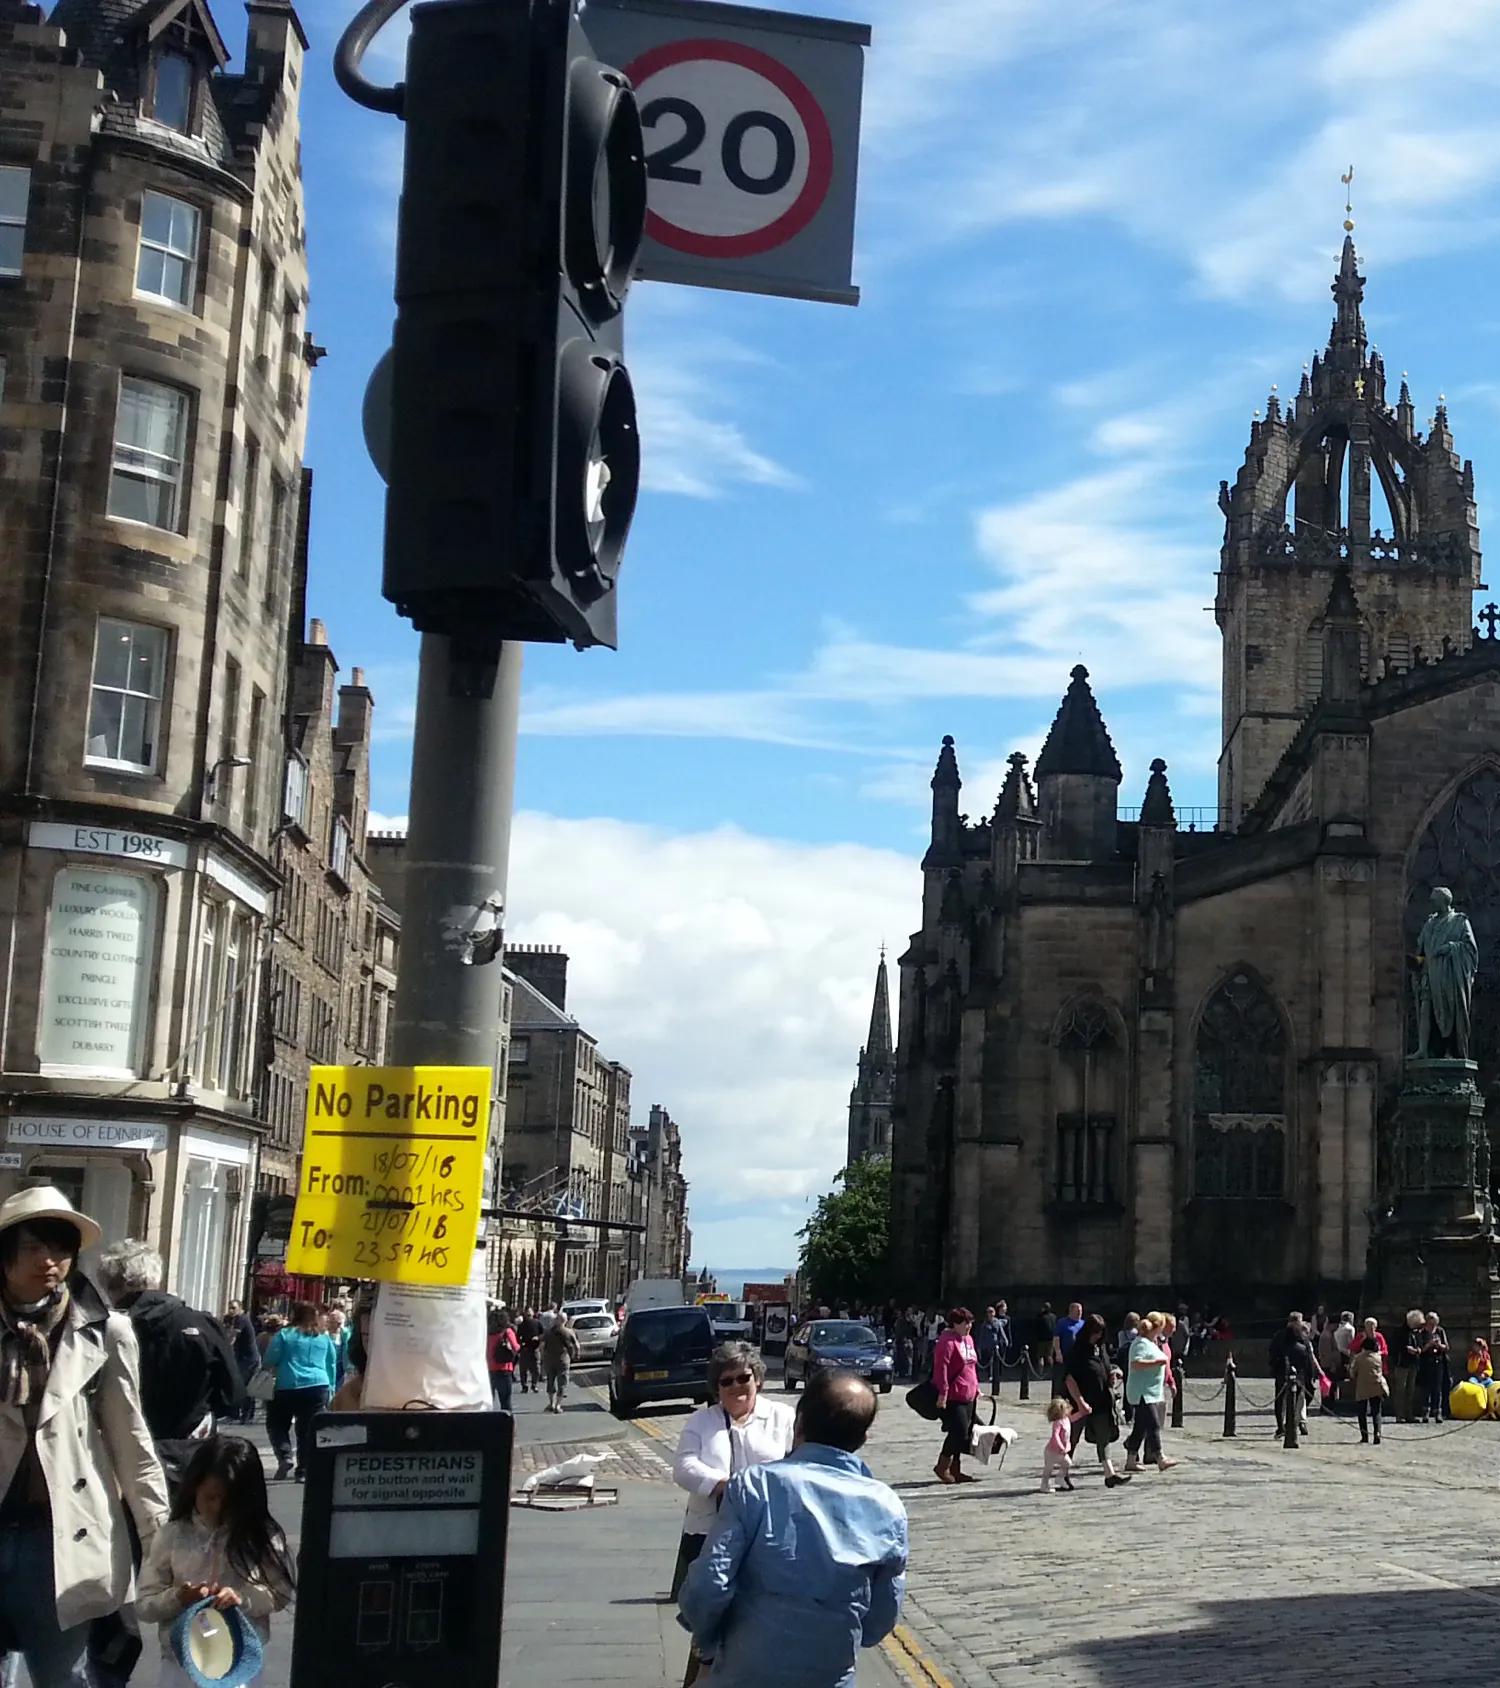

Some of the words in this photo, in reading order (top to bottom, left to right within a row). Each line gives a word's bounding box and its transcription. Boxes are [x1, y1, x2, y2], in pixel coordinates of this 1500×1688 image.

[641, 96, 796, 195] 20
[74, 828, 117, 851] EST
[121, 834, 164, 857] 1985
[59, 904, 97, 916] LUXURY
[69, 927, 103, 938] HARRIS
[106, 930, 134, 942] TWEED
[51, 947, 99, 960] COUNTRY
[101, 952, 144, 966] CLOTHING
[81, 972, 118, 984] PRINGLE
[58, 995, 109, 1007] EXCLUSIVE
[54, 1018, 102, 1029] SCOTTISH
[72, 1040, 115, 1054] DUBARRY
[314, 1082, 353, 1118] No
[365, 1083, 479, 1128] Parking
[9, 1121, 67, 1139] HOUSE
[72, 1124, 95, 1140] OF
[98, 1126, 166, 1143] EDINBURGH
[307, 1165, 371, 1197] From:
[300, 1220, 334, 1250] To:
[346, 1456, 476, 1472] PEDESTRIANS
[343, 1474, 375, 1488] push
[378, 1474, 418, 1486] button
[422, 1473, 445, 1485] and
[447, 1472, 475, 1485] wait
[351, 1487, 369, 1500] for
[371, 1487, 409, 1500] signal
[412, 1486, 466, 1501] opposite
